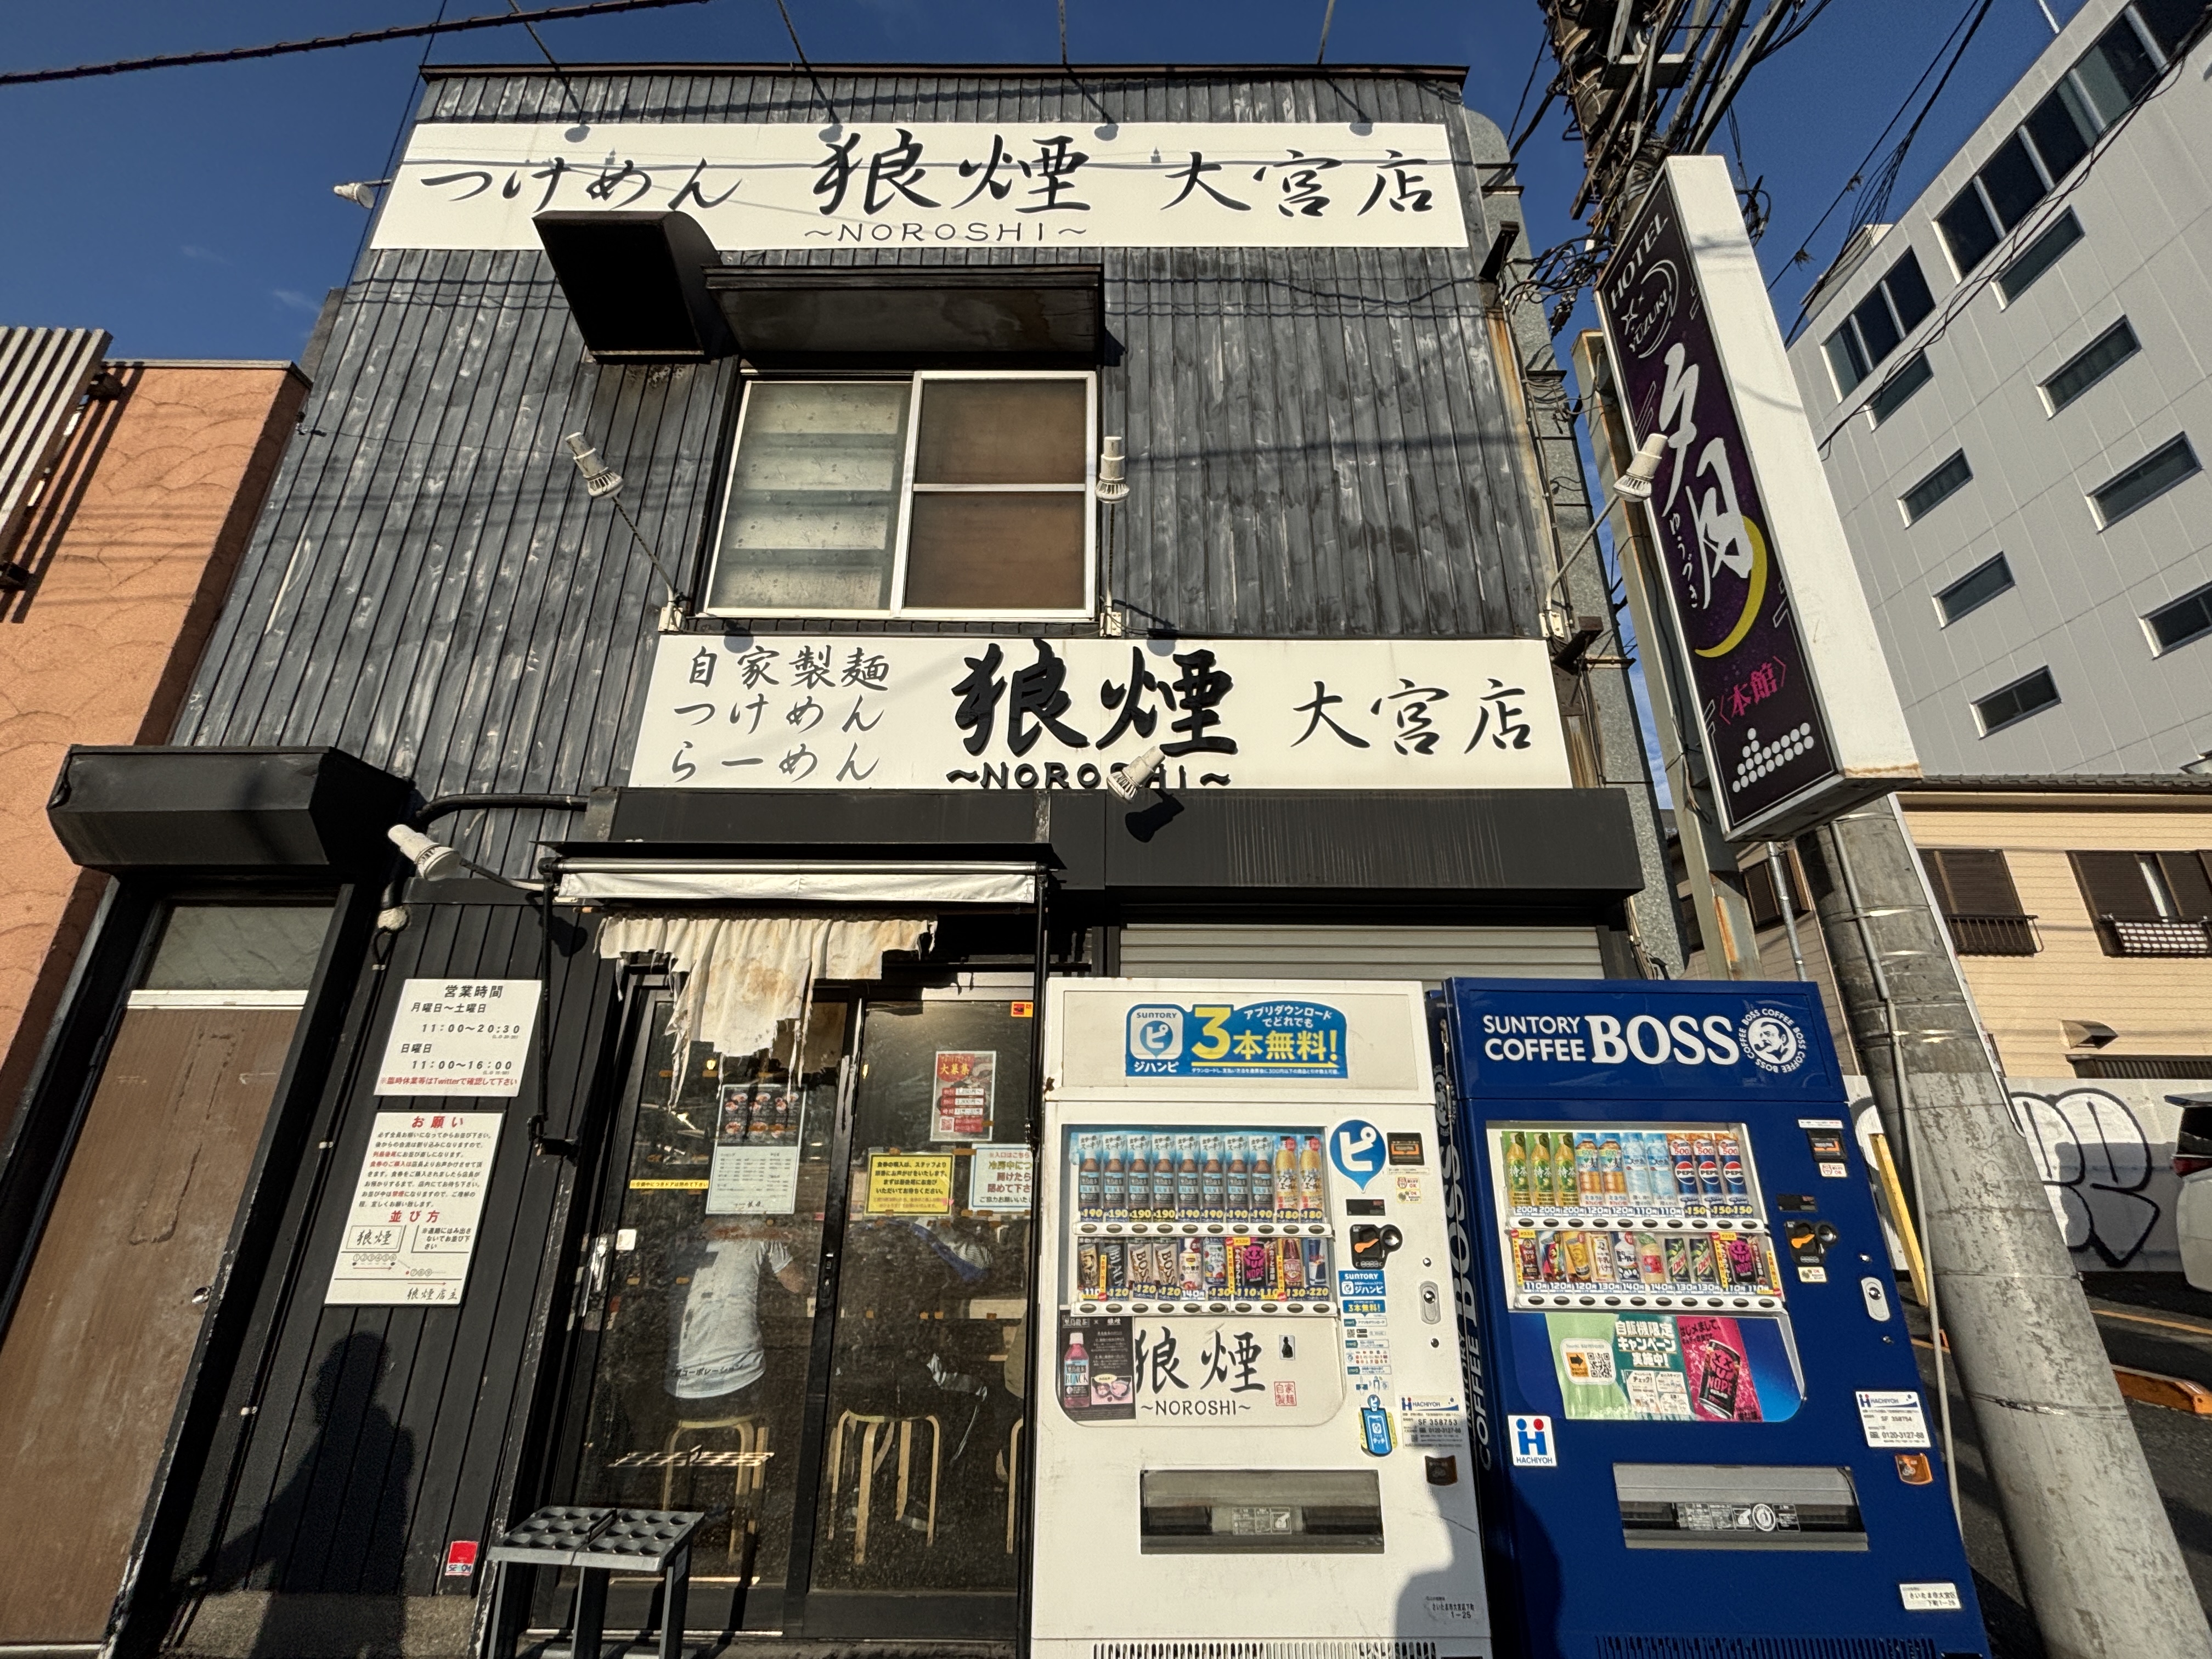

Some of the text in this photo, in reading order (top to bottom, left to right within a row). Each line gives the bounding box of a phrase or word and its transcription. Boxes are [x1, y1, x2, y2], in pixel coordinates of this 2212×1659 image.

[420, 128, 1432, 217] つけめん 狼煙 大宮店
[1611, 213, 1668, 310] HOTEL
[689, 638, 1531, 757] 自家製麺 狼煙 大宮店
[673, 693, 885, 734] つけめん
[672, 740, 880, 782] らーめん
[443, 985, 504, 998] 営業時間
[1244, 1005, 1333, 1020] アプリダウンロード
[1741, 1009, 1760, 1026] BOSS
[1762, 1008, 1795, 1026] COFFEE
[1262, 1017, 1314, 1028] でどれでも
[1483, 1015, 1581, 1034] SUNTORY
[1584, 1015, 1740, 1065] BOSS
[1739, 1028, 1755, 1059] COFFEE
[1792, 1026, 1807, 1050] BOSS
[400, 1043, 432, 1053] 日曜日
[1485, 1038, 1587, 1061] COFFEE
[940, 1063, 970, 1075] 大募集
[1134, 1061, 1179, 1073] ジハンピ
[411, 1115, 464, 1128] お願い
[1509, 1165, 1528, 1177] 特茶
[1534, 1166, 1552, 1178] 特茶
[1558, 1166, 1576, 1178] 特茶
[388, 1210, 440, 1223] 並び方
[357, 1229, 392, 1245] 狼煙
[1246, 1267, 1265, 1279] NOPE
[1735, 1263, 1753, 1273] NOPE
[1355, 1285, 1384, 1294] ジハンピ
[1616, 1321, 1674, 1337] 自販機限定
[1618, 1337, 1676, 1352] キャンペーン
[1135, 1326, 1266, 1393] 狼煙
[1707, 1375, 1733, 1396] NOPE
